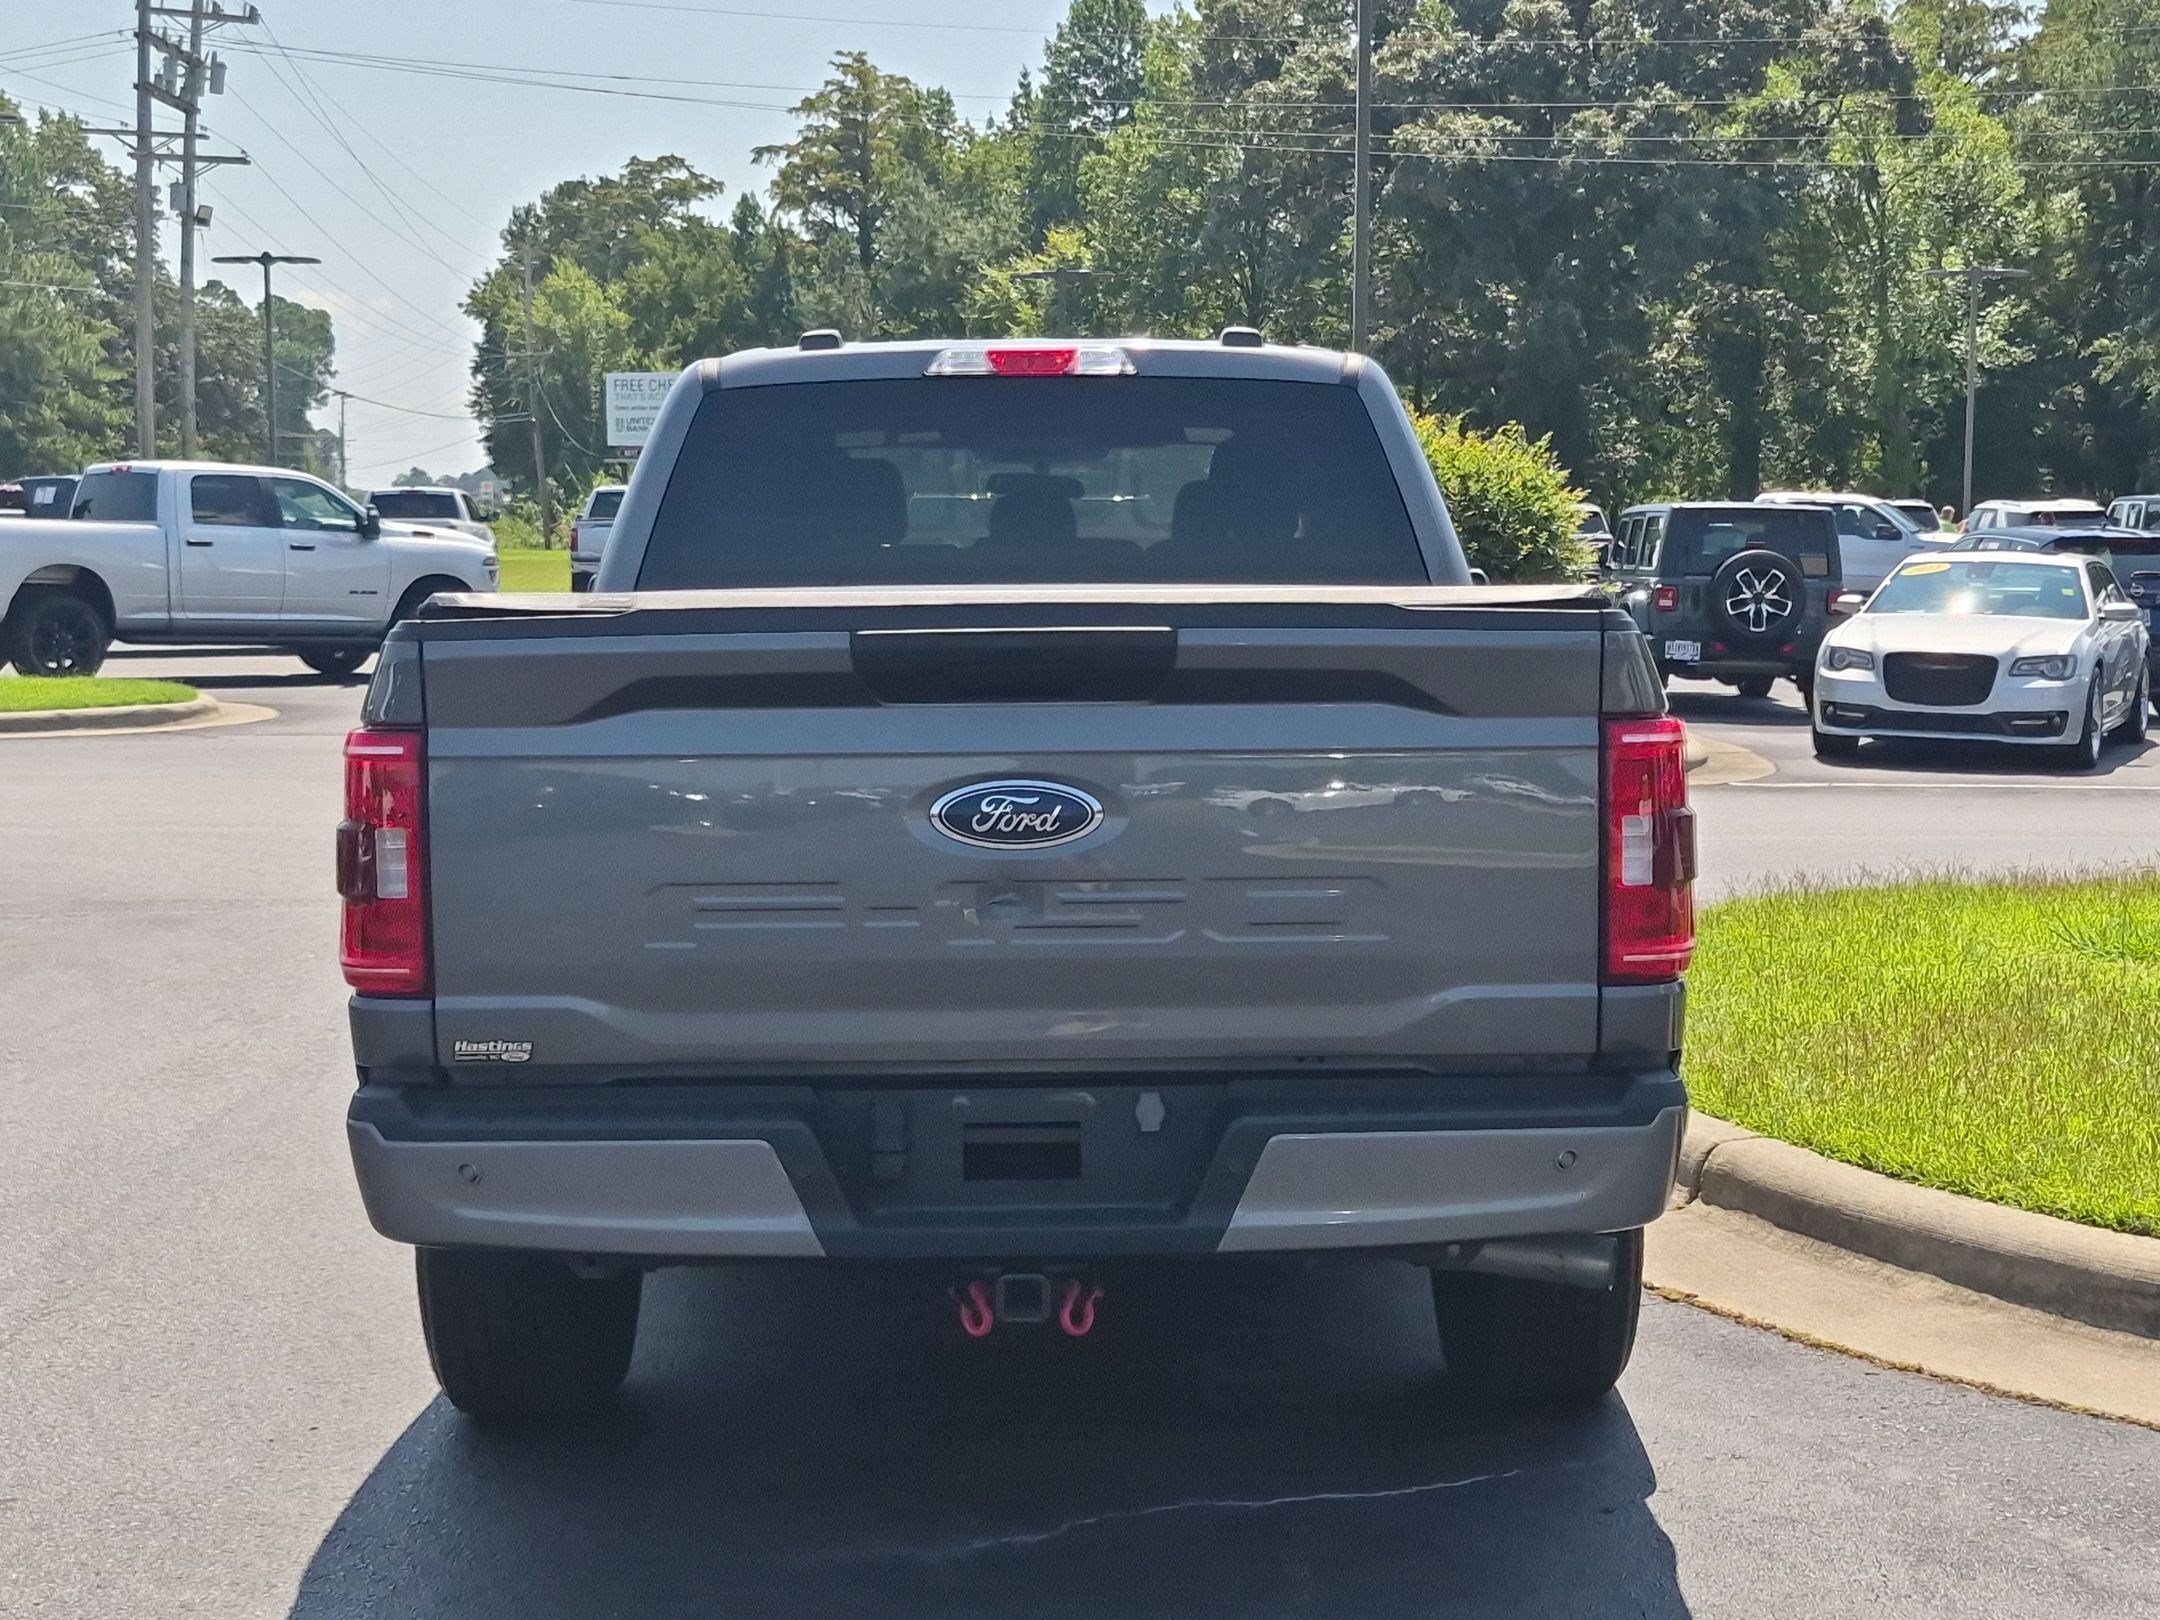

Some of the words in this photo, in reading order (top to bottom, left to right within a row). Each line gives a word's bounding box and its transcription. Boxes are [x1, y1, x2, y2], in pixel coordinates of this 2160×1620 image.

[613, 379, 645, 392] FREE
[971, 795, 1063, 833] Ford
[454, 1040, 533, 1053] Hastings
